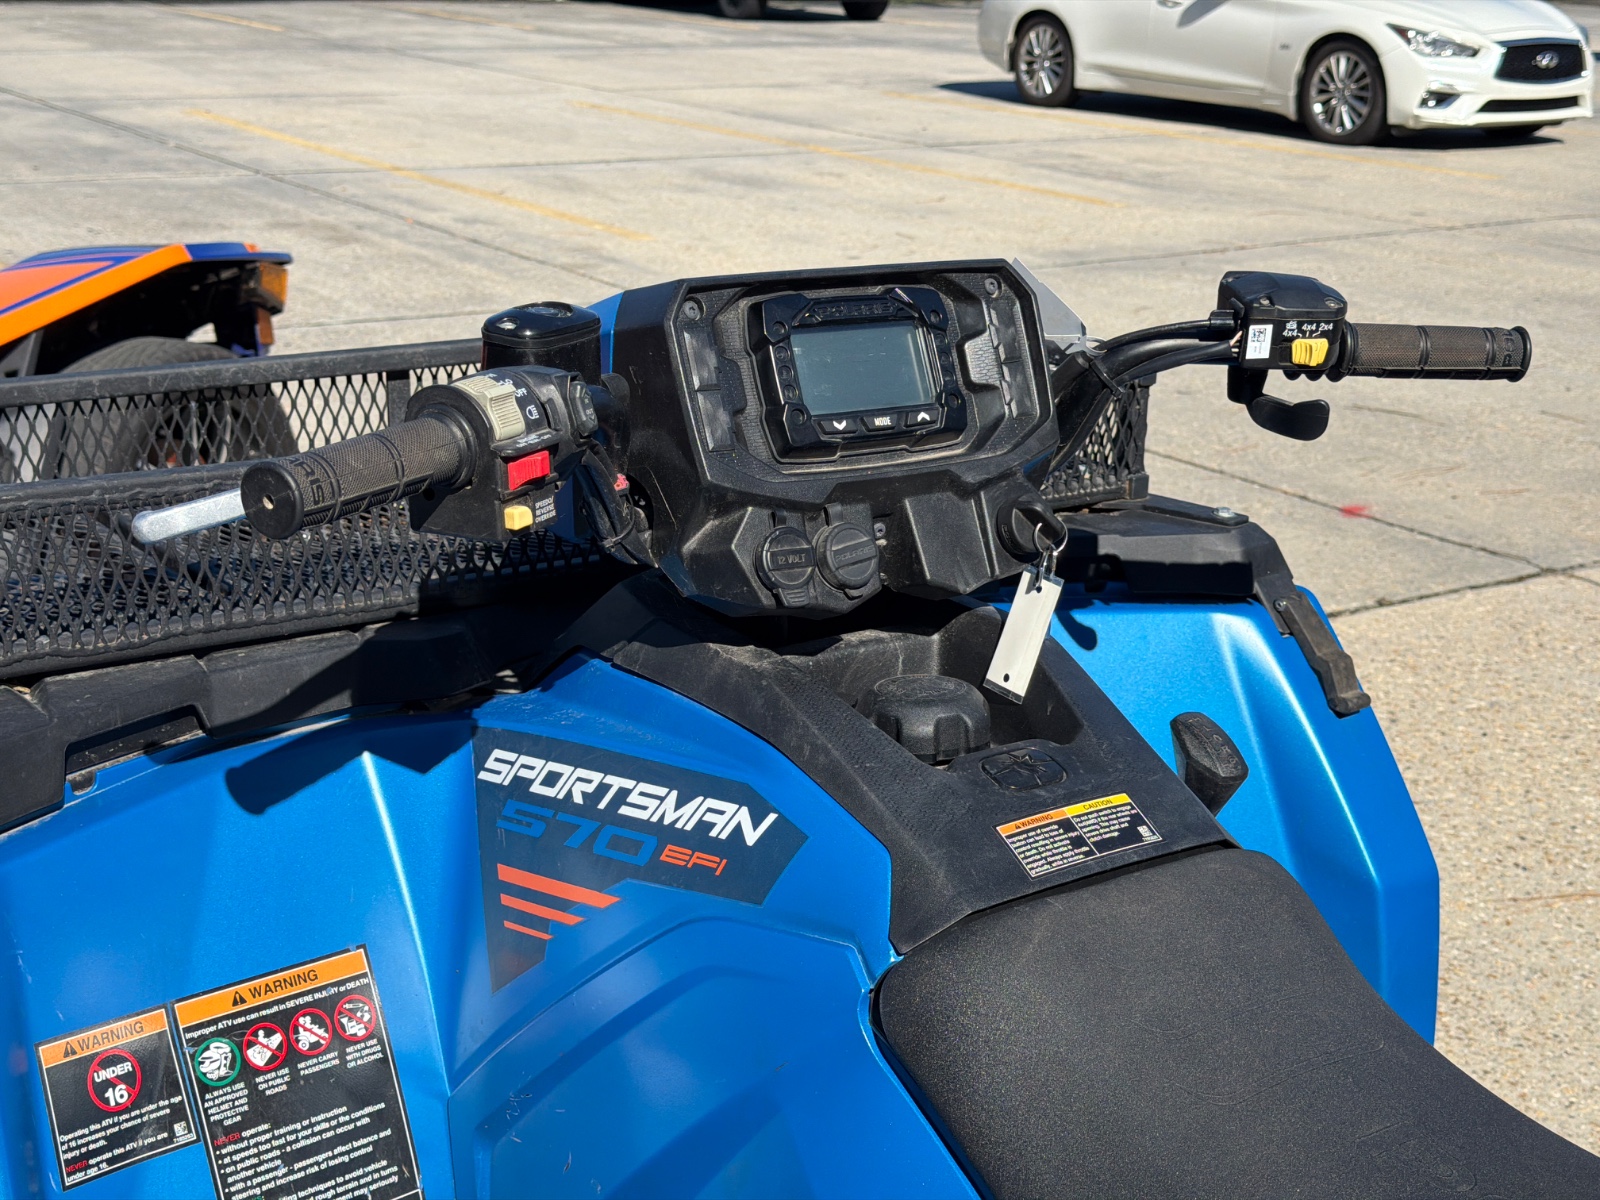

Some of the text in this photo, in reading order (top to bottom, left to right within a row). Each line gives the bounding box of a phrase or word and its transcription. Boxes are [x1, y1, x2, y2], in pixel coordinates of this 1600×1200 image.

[874, 416, 892, 426] MODE
[534, 510, 556, 523] OVERRIDE
[536, 503, 554, 516] REVERSE
[777, 554, 806, 564] 12 VOLT
[836, 544, 876, 561] POLARIS
[477, 748, 778, 846] SPORTSMAN
[1083, 799, 1112, 810] CAUTION
[1020, 814, 1054, 828] WARNING
[496, 800, 728, 876] 570 EFI
[248, 969, 317, 998] WARNING
[185, 1025, 216, 1039] Improper
[217, 1019, 231, 1028] ATV
[259, 1005, 278, 1016] result
[285, 994, 313, 1007] SEVERE
[346, 977, 368, 989] DEATH
[77, 1021, 143, 1051] WARNING
[346, 1042, 365, 1052] NEVER
[346, 1044, 380, 1060] WITH DRUGS
[297, 1051, 337, 1068] NEVER CARRY
[300, 1058, 339, 1075] PASSENGERS
[356, 1052, 382, 1064] ALCOHOL
[93, 1062, 131, 1081] UNDER
[255, 1067, 288, 1082] NEVER USE
[268, 1075, 290, 1086] PUBLIC
[104, 1083, 129, 1107] 16
[205, 1082, 244, 1099] ALWAYS USE
[214, 1089, 248, 1104] APPROVED
[265, 1084, 286, 1095] ROADS
[208, 1097, 247, 1114] HELMET AND
[210, 1104, 248, 1121] PROTECTIVE
[59, 1127, 89, 1141] Operating
[101, 1117, 112, 1126] ATV
[118, 1113, 129, 1122] you
[140, 1103, 157, 1113] under
[76, 1131, 105, 1144] increases
[105, 1125, 119, 1135] your
[120, 1118, 141, 1129] chance
[149, 1108, 169, 1118] severe
[223, 1115, 241, 1125] GEAR
[214, 1123, 270, 1145] NEVER operate:
[220, 1140, 248, 1154] without
[249, 1132, 272, 1145] proper
[273, 1122, 301, 1136] training
[310, 1106, 347, 1122] instruction
[231, 1147, 258, 1160] speeds
[258, 1143, 271, 1151] too
[271, 1136, 285, 1146] fast
[297, 1128, 311, 1139] your
[313, 1122, 329, 1132] skills
[350, 1102, 385, 1118] conditions
[236, 1157, 258, 1170] public
[259, 1149, 280, 1160] roads
[291, 1135, 320, 1149] collision
[321, 1130, 334, 1138] can
[335, 1122, 354, 1133] occur
[355, 1117, 370, 1126] with
[62, 1149, 79, 1159] injury
[65, 1160, 87, 1171] NEVER
[88, 1152, 112, 1164] operate
[125, 1141, 137, 1150] ATV
[143, 1136, 156, 1145] you
[229, 1182, 245, 1191] with
[252, 1166, 287, 1185] passenger
[293, 1150, 332, 1170] passengers
[333, 1142, 352, 1154] affect
[352, 1134, 378, 1147] balance
[378, 1128, 391, 1138] and
[67, 1171, 85, 1181] under
[227, 1159, 281, 1182] another vehicle
[231, 1144, 372, 1200] steering and increase risk of losing control
[297, 1179, 335, 1197] techniques
[344, 1167, 363, 1180] avoid
[363, 1160, 387, 1172] vehicle
[315, 1188, 335, 1200] rough
[336, 1181, 358, 1192] terrain
[359, 1174, 372, 1184] and
[380, 1165, 397, 1176] turns
[353, 1186, 368, 1196] may
[369, 1175, 398, 1190] seriously
